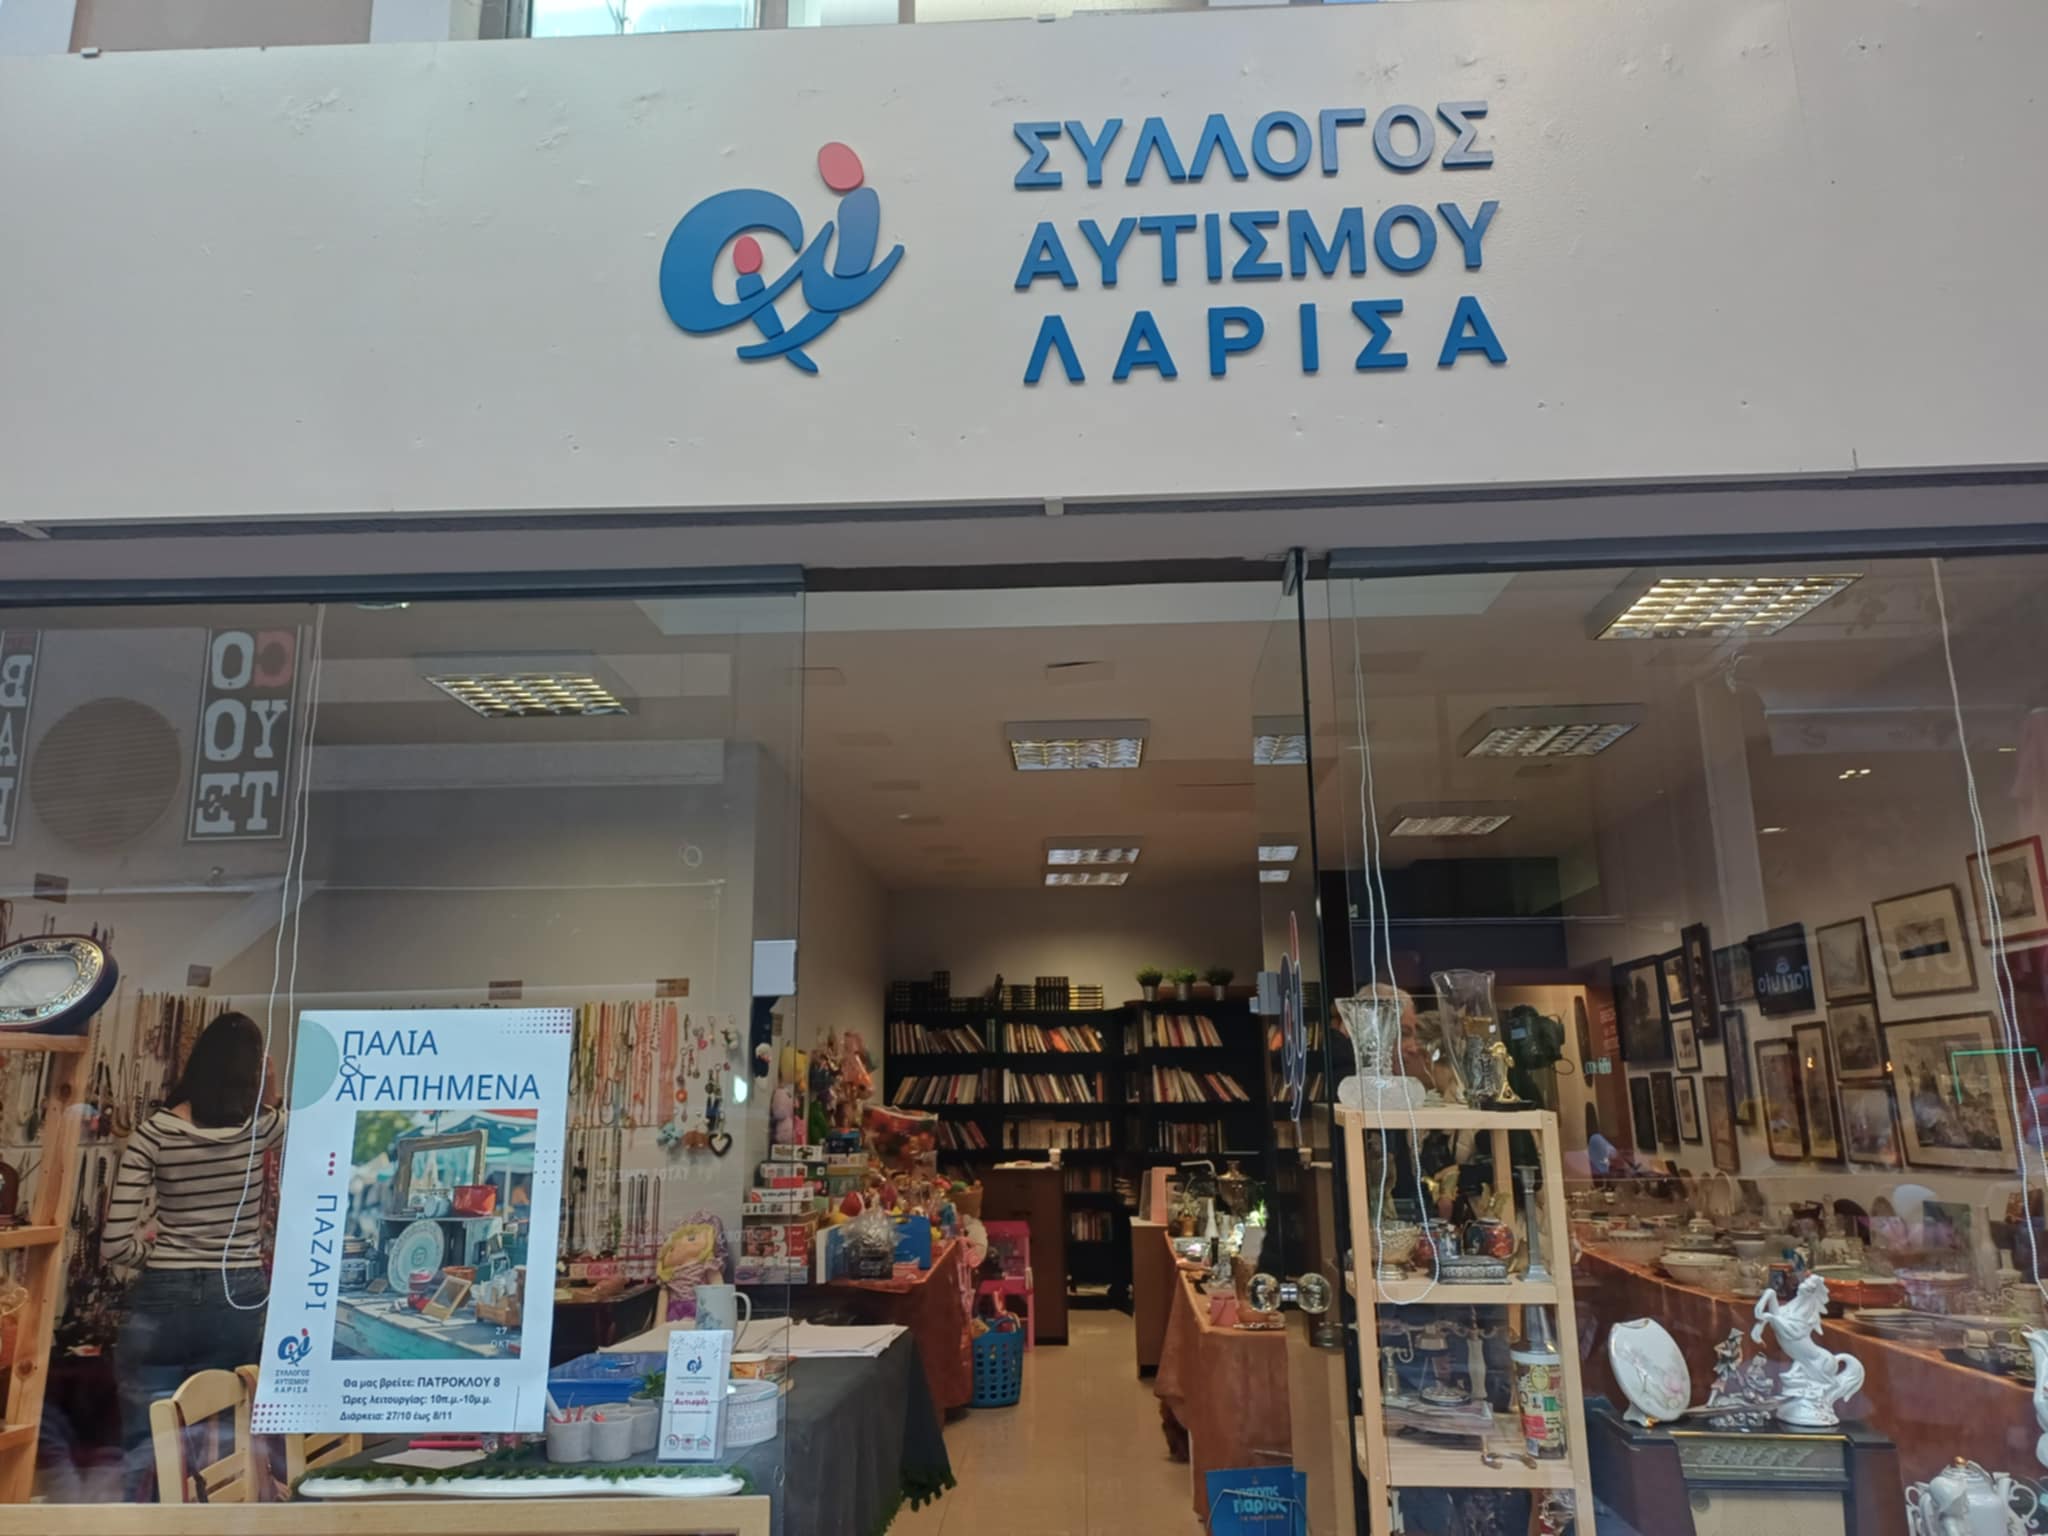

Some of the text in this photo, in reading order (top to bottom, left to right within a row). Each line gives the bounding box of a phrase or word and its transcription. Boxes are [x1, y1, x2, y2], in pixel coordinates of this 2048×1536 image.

[1013, 100, 1494, 191] ΣΥΛΛΟΓΟΣ
[1014, 201, 1500, 289] ΑΥΤΙΣΜΟΥ
[1023, 295, 1508, 384] ΛΑΡΙΣΑ
[342, 1030, 438, 1056] ΠΑΛΙΑ
[339, 1055, 366, 1078] &
[336, 1074, 540, 1101] ΑΓΑΠΗΜΕΝΑ
[305, 1194, 338, 1311] ΠΑΖΑΡΙ
[495, 1326, 508, 1336] 27
[343, 1377, 501, 1389] Θα μας βρείτε: ΠΑΤΡΟΚΛΟΥ 8
[342, 1395, 367, 1405] Ώρες
[369, 1395, 427, 1406] λειτουργίας:
[339, 1411, 452, 1422] Διάρκεια: 27/10 έως 8/11
